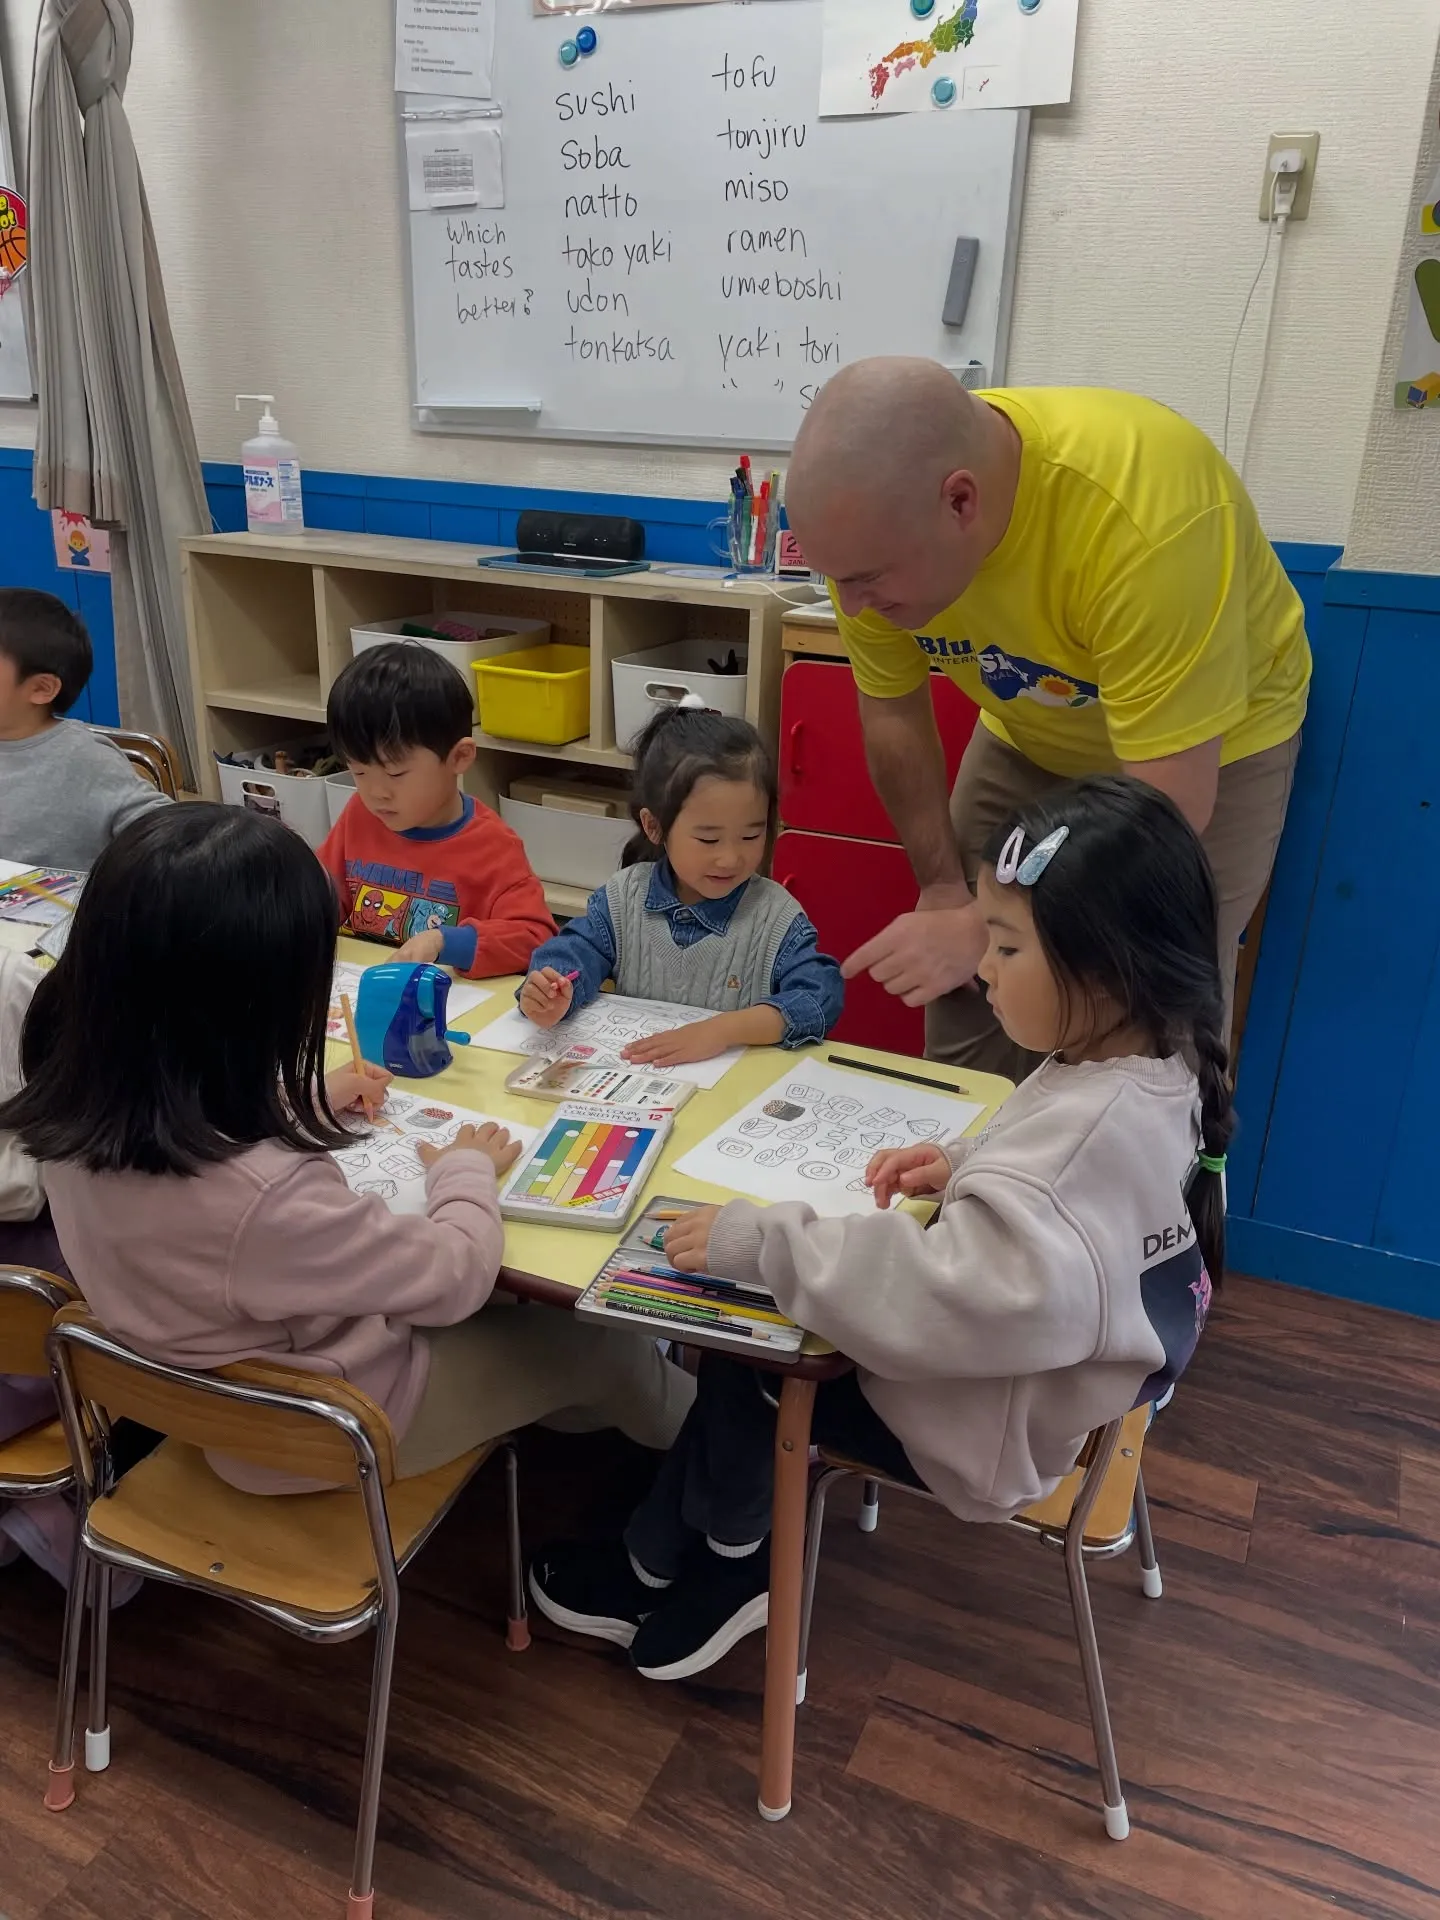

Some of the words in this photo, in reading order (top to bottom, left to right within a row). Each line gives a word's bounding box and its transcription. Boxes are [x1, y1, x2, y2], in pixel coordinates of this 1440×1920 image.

[711, 52, 776, 91] tofu
[555, 79, 635, 121] sushi
[716, 118, 807, 160] tonjiru
[565, 183, 638, 219] natto
[724, 171, 789, 202] miso
[726, 226, 808, 258] ramen
[445, 246, 514, 282] tastes
[566, 277, 629, 316] udon
[721, 268, 842, 301] umeboshi
[647, 1113, 663, 1121] 12
